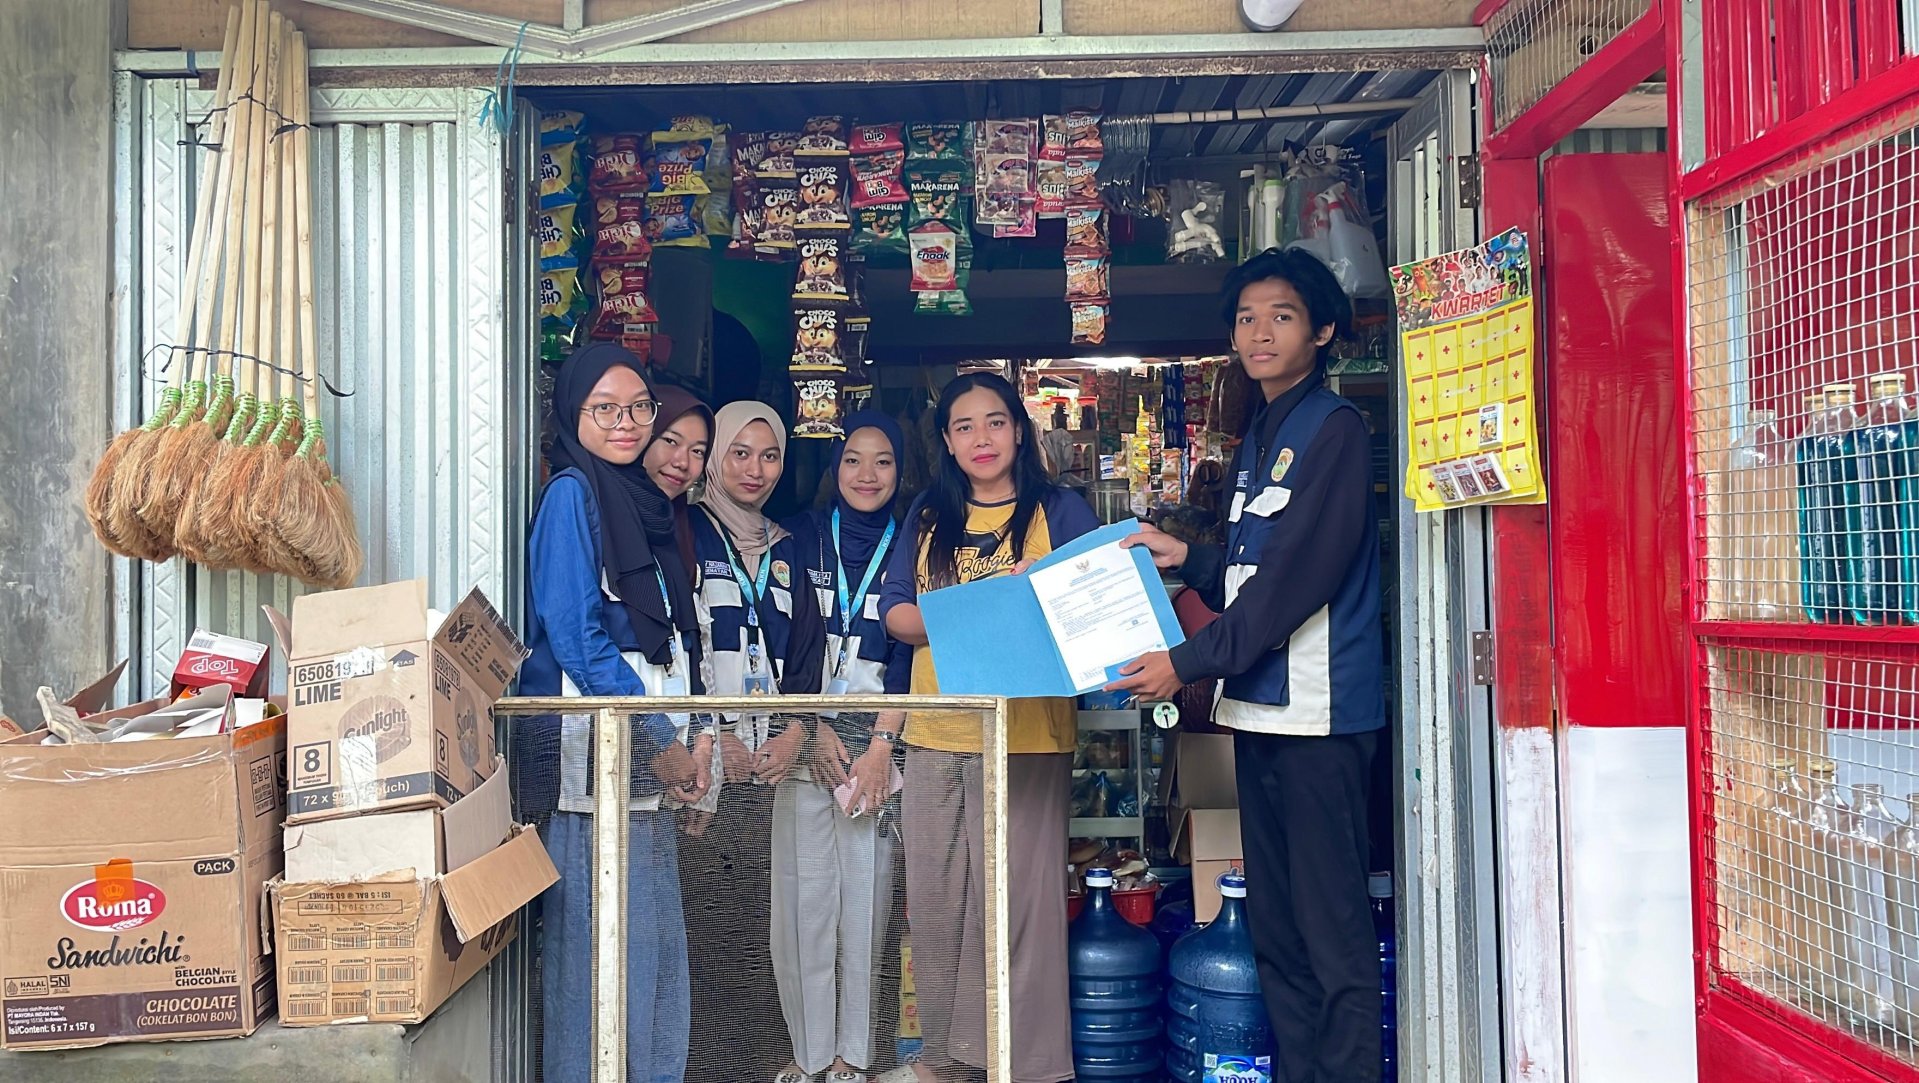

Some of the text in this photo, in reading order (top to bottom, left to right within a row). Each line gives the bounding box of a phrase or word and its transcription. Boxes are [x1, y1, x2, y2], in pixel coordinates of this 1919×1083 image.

[1047, 132, 1067, 145] lus
[596, 150, 641, 173] Qtela
[659, 164, 693, 175] Prize
[808, 166, 837, 174] CHOCO
[662, 174, 686, 186] BIG
[800, 172, 839, 187] CHIPS
[868, 186, 891, 198] Gim
[911, 182, 960, 193] MAKARENA
[650, 203, 685, 214] Prize
[599, 220, 643, 245] Qtela
[801, 243, 839, 258] CHIPS
[917, 250, 950, 262] Enaak
[602, 291, 649, 314] Qtela
[807, 309, 836, 317] CHOCO
[799, 315, 838, 330] CHIPS
[806, 379, 836, 387] CHOCO
[799, 385, 838, 400] CHIPS
[298, 660, 373, 683] 650819
[295, 682, 342, 707] LIME
[435, 672, 452, 702] LIME
[439, 737, 446, 762] 8
[303, 748, 321, 773] 8
[304, 795, 318, 806] 72
[321, 796, 329, 804] x
[197, 860, 232, 875] PACK
[77, 895, 153, 919] Roma
[47, 931, 186, 970] Sandwichi
[175, 967, 220, 978] BELGIAN
[20, 981, 46, 989] HALAL
[175, 975, 237, 987] CHOCOLATE
[146, 995, 238, 1014] CHOCOLATE
[137, 1009, 237, 1029] (COKELAT BON BON)
[50, 1024, 56, 1033] 6
[63, 1023, 68, 1032] 7
[75, 1021, 88, 1031] 157
[89, 1023, 95, 1032] g
